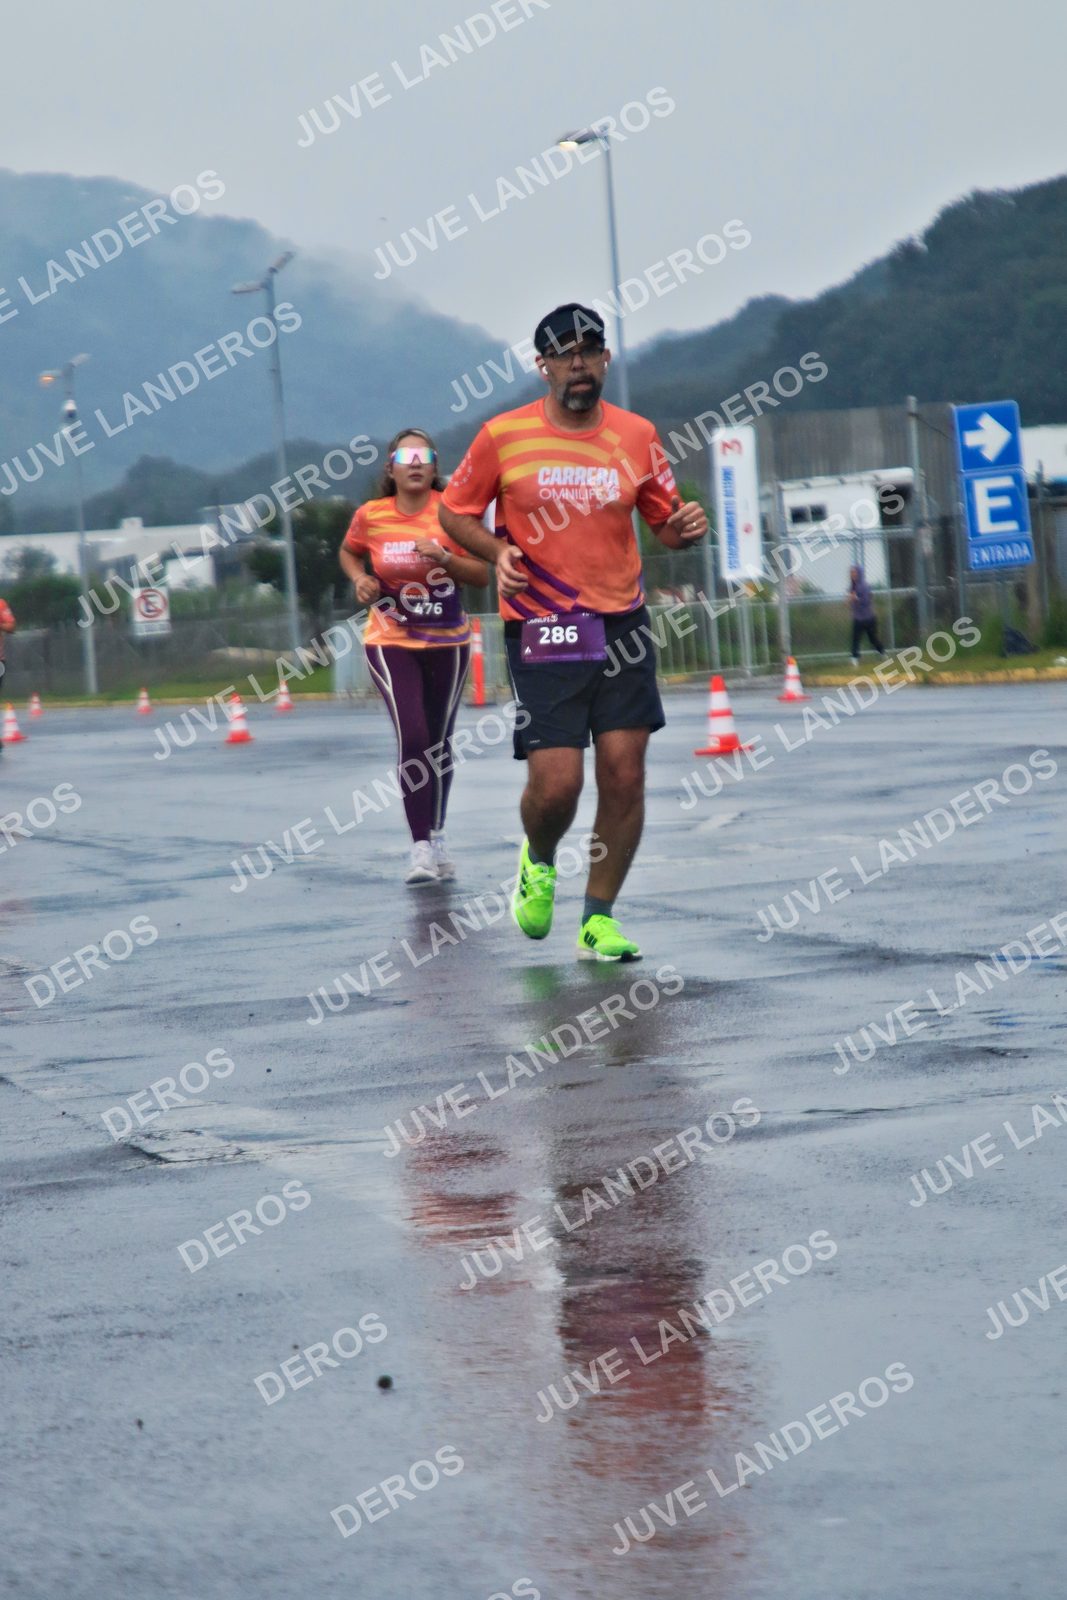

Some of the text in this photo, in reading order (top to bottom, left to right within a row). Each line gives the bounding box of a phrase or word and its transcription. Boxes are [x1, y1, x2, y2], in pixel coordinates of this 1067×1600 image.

[538, 466, 619, 486] CARRERA
[973, 475, 1020, 535] E
[414, 602, 443, 615] 476
[539, 625, 578, 645] 286
